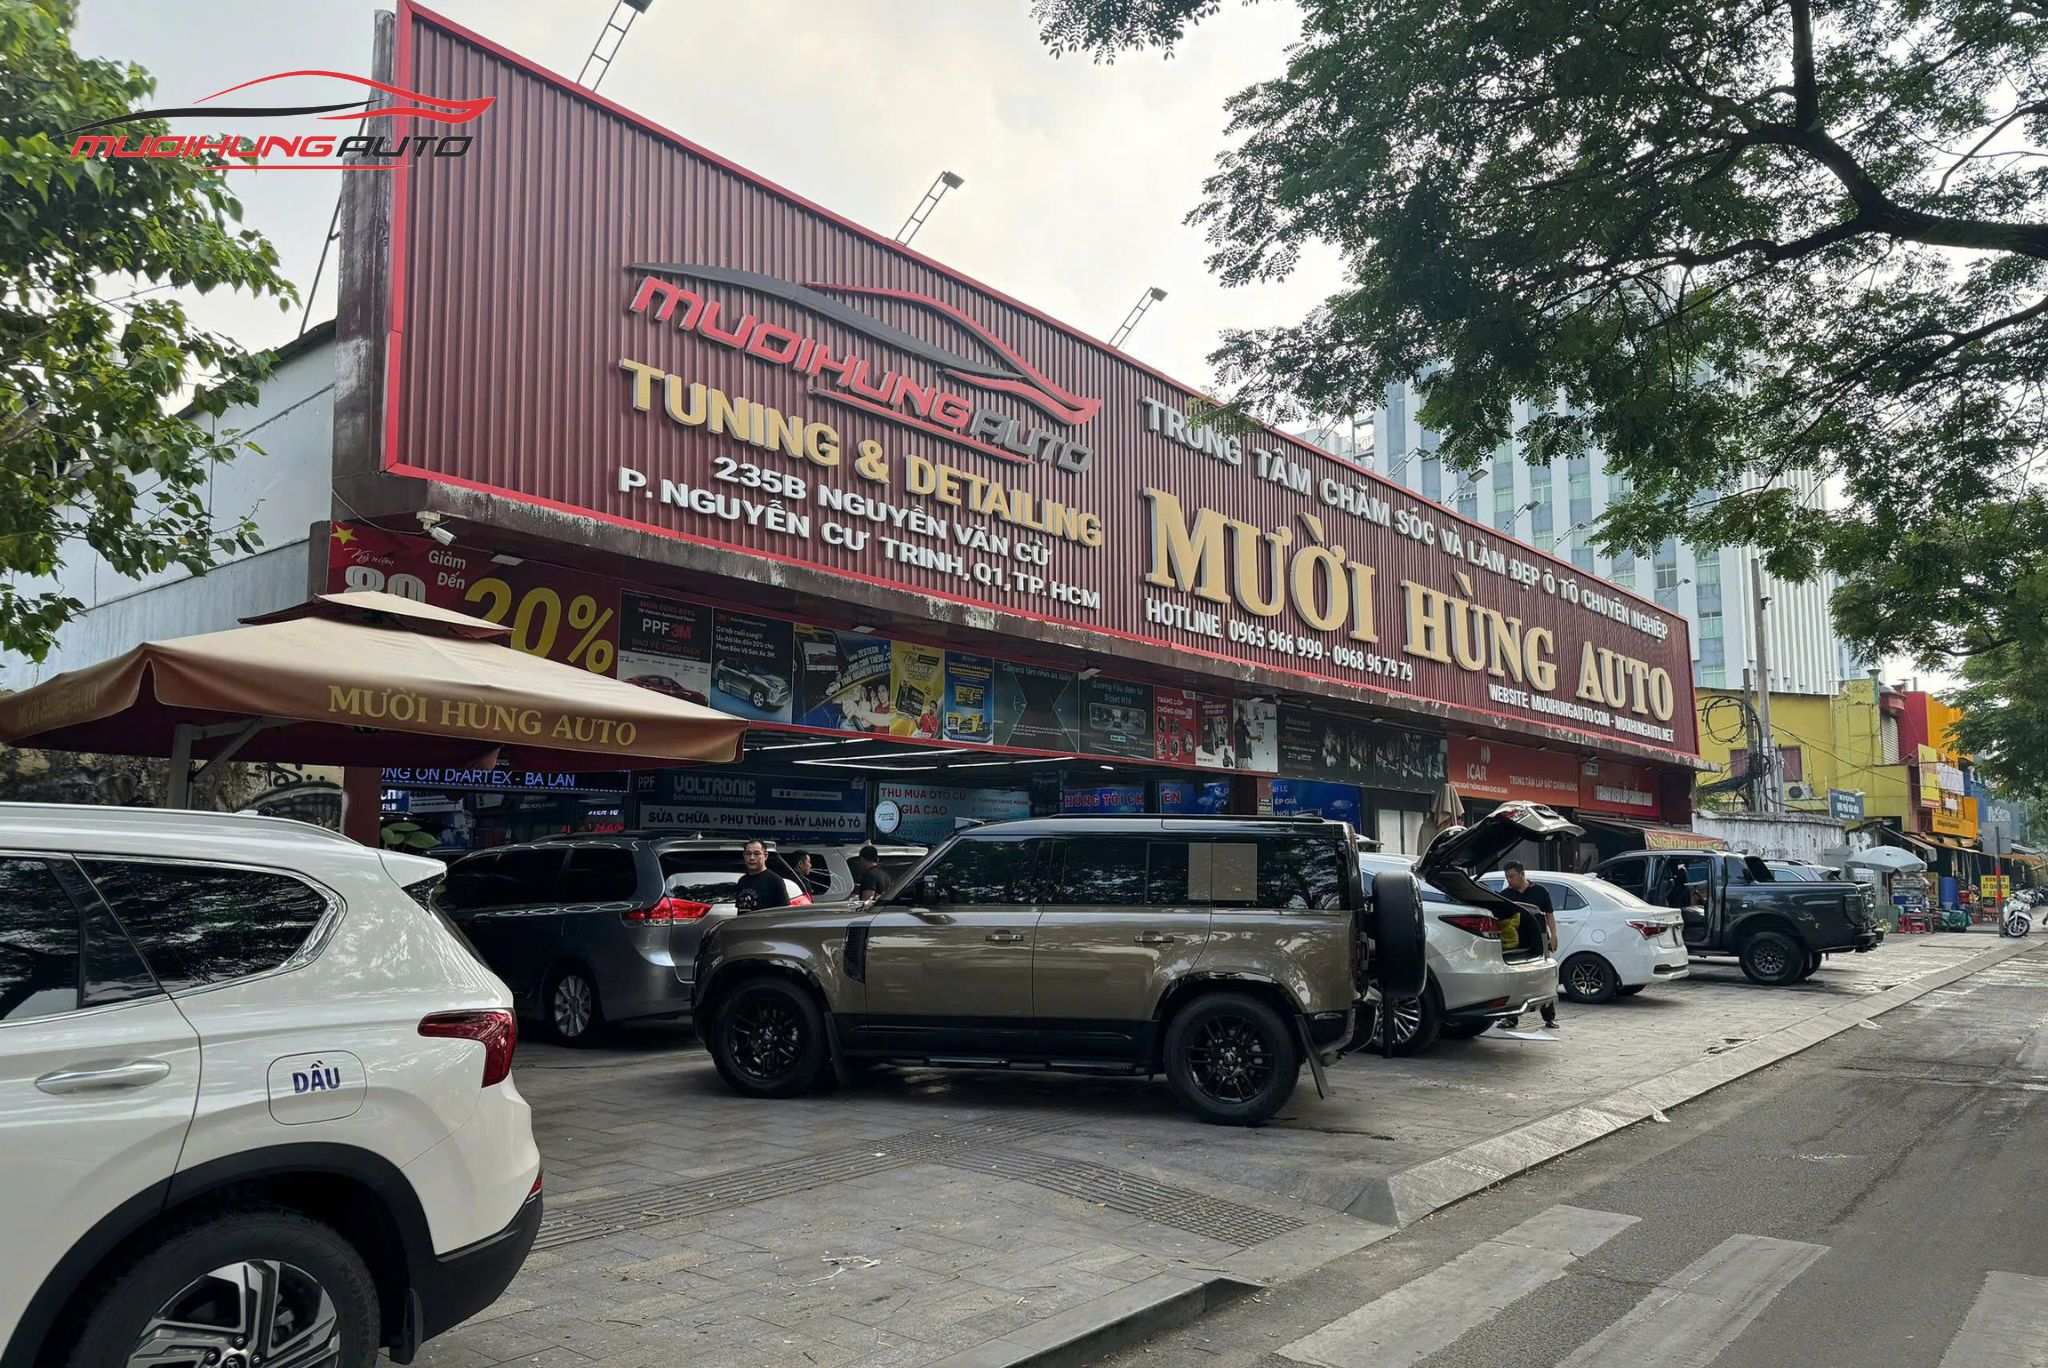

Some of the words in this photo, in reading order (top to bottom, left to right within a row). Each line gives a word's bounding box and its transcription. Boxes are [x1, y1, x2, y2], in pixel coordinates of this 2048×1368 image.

[619, 359, 840, 466] TUNING
[854, 438, 890, 485] &
[906, 454, 1102, 548] DETAILING
[618, 466, 654, 499] P.
[660, 478, 810, 539] NGUYỄN
[821, 521, 871, 551] CƯ
[713, 456, 807, 500] 235B
[817, 483, 947, 540] NGUYỄN
[953, 521, 1008, 557] VĂN
[1014, 539, 1052, 566] CỪ
[1142, 396, 1243, 466] TRUNG
[1252, 447, 1312, 496] TÂM
[1319, 482, 1390, 528] CHĂM
[1394, 507, 1435, 546] SÓC
[1440, 525, 1464, 560] VÀ
[1467, 538, 1506, 576] LÀM
[1508, 558, 1540, 591] ĐẸP
[1543, 568, 1555, 595] Ô
[1558, 578, 1579, 604] TÔ
[1581, 588, 1630, 625] CHUYÊN
[1630, 610, 1668, 643] NGHIỆP
[428, 550, 466, 569] Giảm
[437, 571, 465, 590] Đến
[1144, 486, 1380, 644] MƯỜI
[1400, 571, 1557, 692] HÙNG
[1575, 641, 1674, 722] AUTO
[465, 577, 615, 674] 20%
[1228, 618, 1266, 649] 0965
[1267, 629, 1294, 655] 966
[1296, 636, 1323, 661] 999
[1332, 645, 1365, 671] 0968
[327, 684, 428, 725] MƯỜI
[439, 697, 543, 737] HÙNG
[551, 716, 637, 747] AUTO
[444, 768, 512, 786] DrARTEX
[525, 772, 544, 786] BA
[547, 773, 576, 787] LAN
[638, 775, 656, 789] PPF
[1466, 763, 1487, 781] ICAR
[881, 787, 901, 798] THU
[904, 788, 927, 799] MUA
[923, 804, 948, 816] CAO
[648, 810, 674, 824] SỬA
[677, 810, 711, 824] CHỮA
[720, 814, 743, 828] PHỤ
[746, 812, 776, 826] TÙNG
[784, 814, 807, 827] MÁY
[808, 815, 837, 830] LẠNH
[292, 1060, 341, 1094] DẦU
